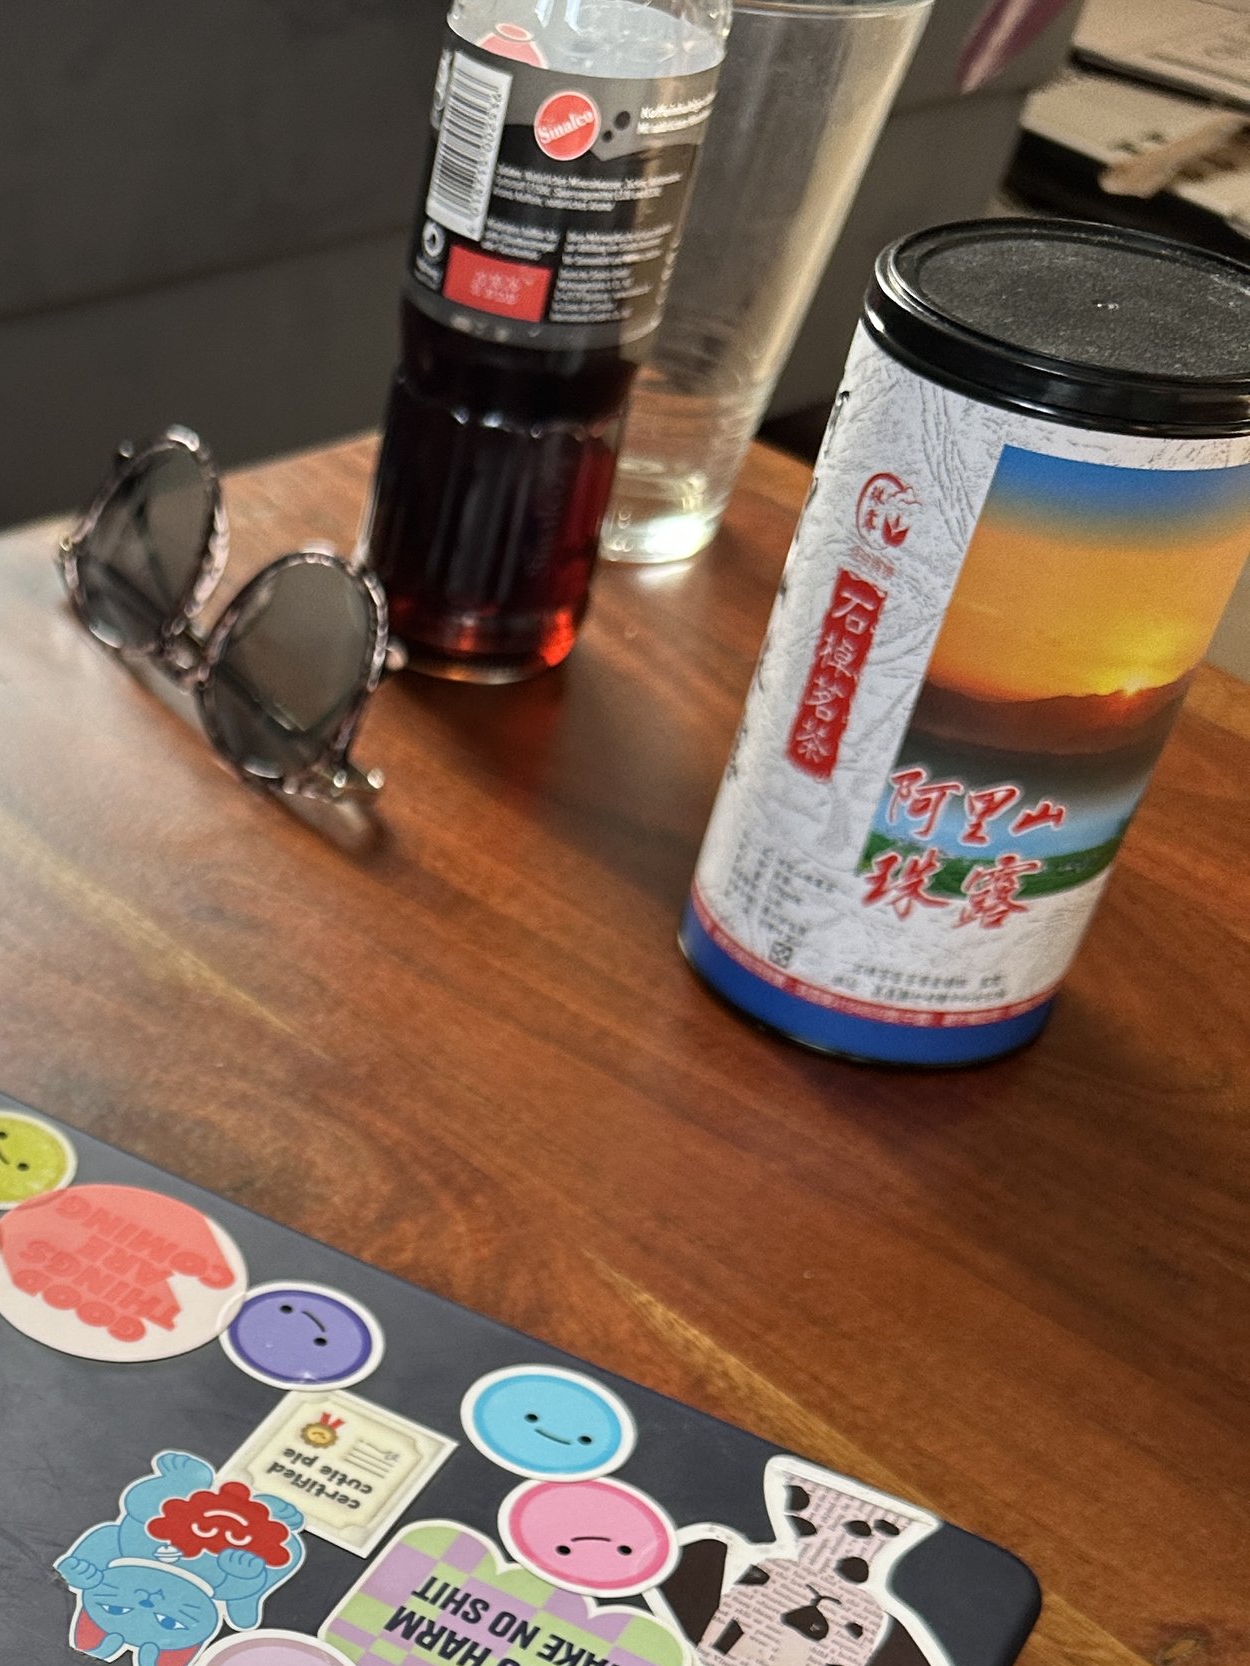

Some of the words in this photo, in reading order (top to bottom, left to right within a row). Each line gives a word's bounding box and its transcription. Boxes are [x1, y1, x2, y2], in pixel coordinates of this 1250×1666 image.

[537, 110, 595, 145] Sinalco
[886, 768, 1066, 846] 阿里山
[861, 848, 1042, 929] 珠露
[55, 1195, 235, 1290] COMING
[78, 1235, 175, 1286] ARE
[13, 1269, 146, 1343] GOOD
[18, 1239, 182, 1332] THINGS
[282, 1448, 318, 1468] pie
[320, 1465, 373, 1495] cutie
[266, 1462, 361, 1510] certified
[411, 1576, 490, 1624] SHIT
[488, 1610, 541, 1650] NO
